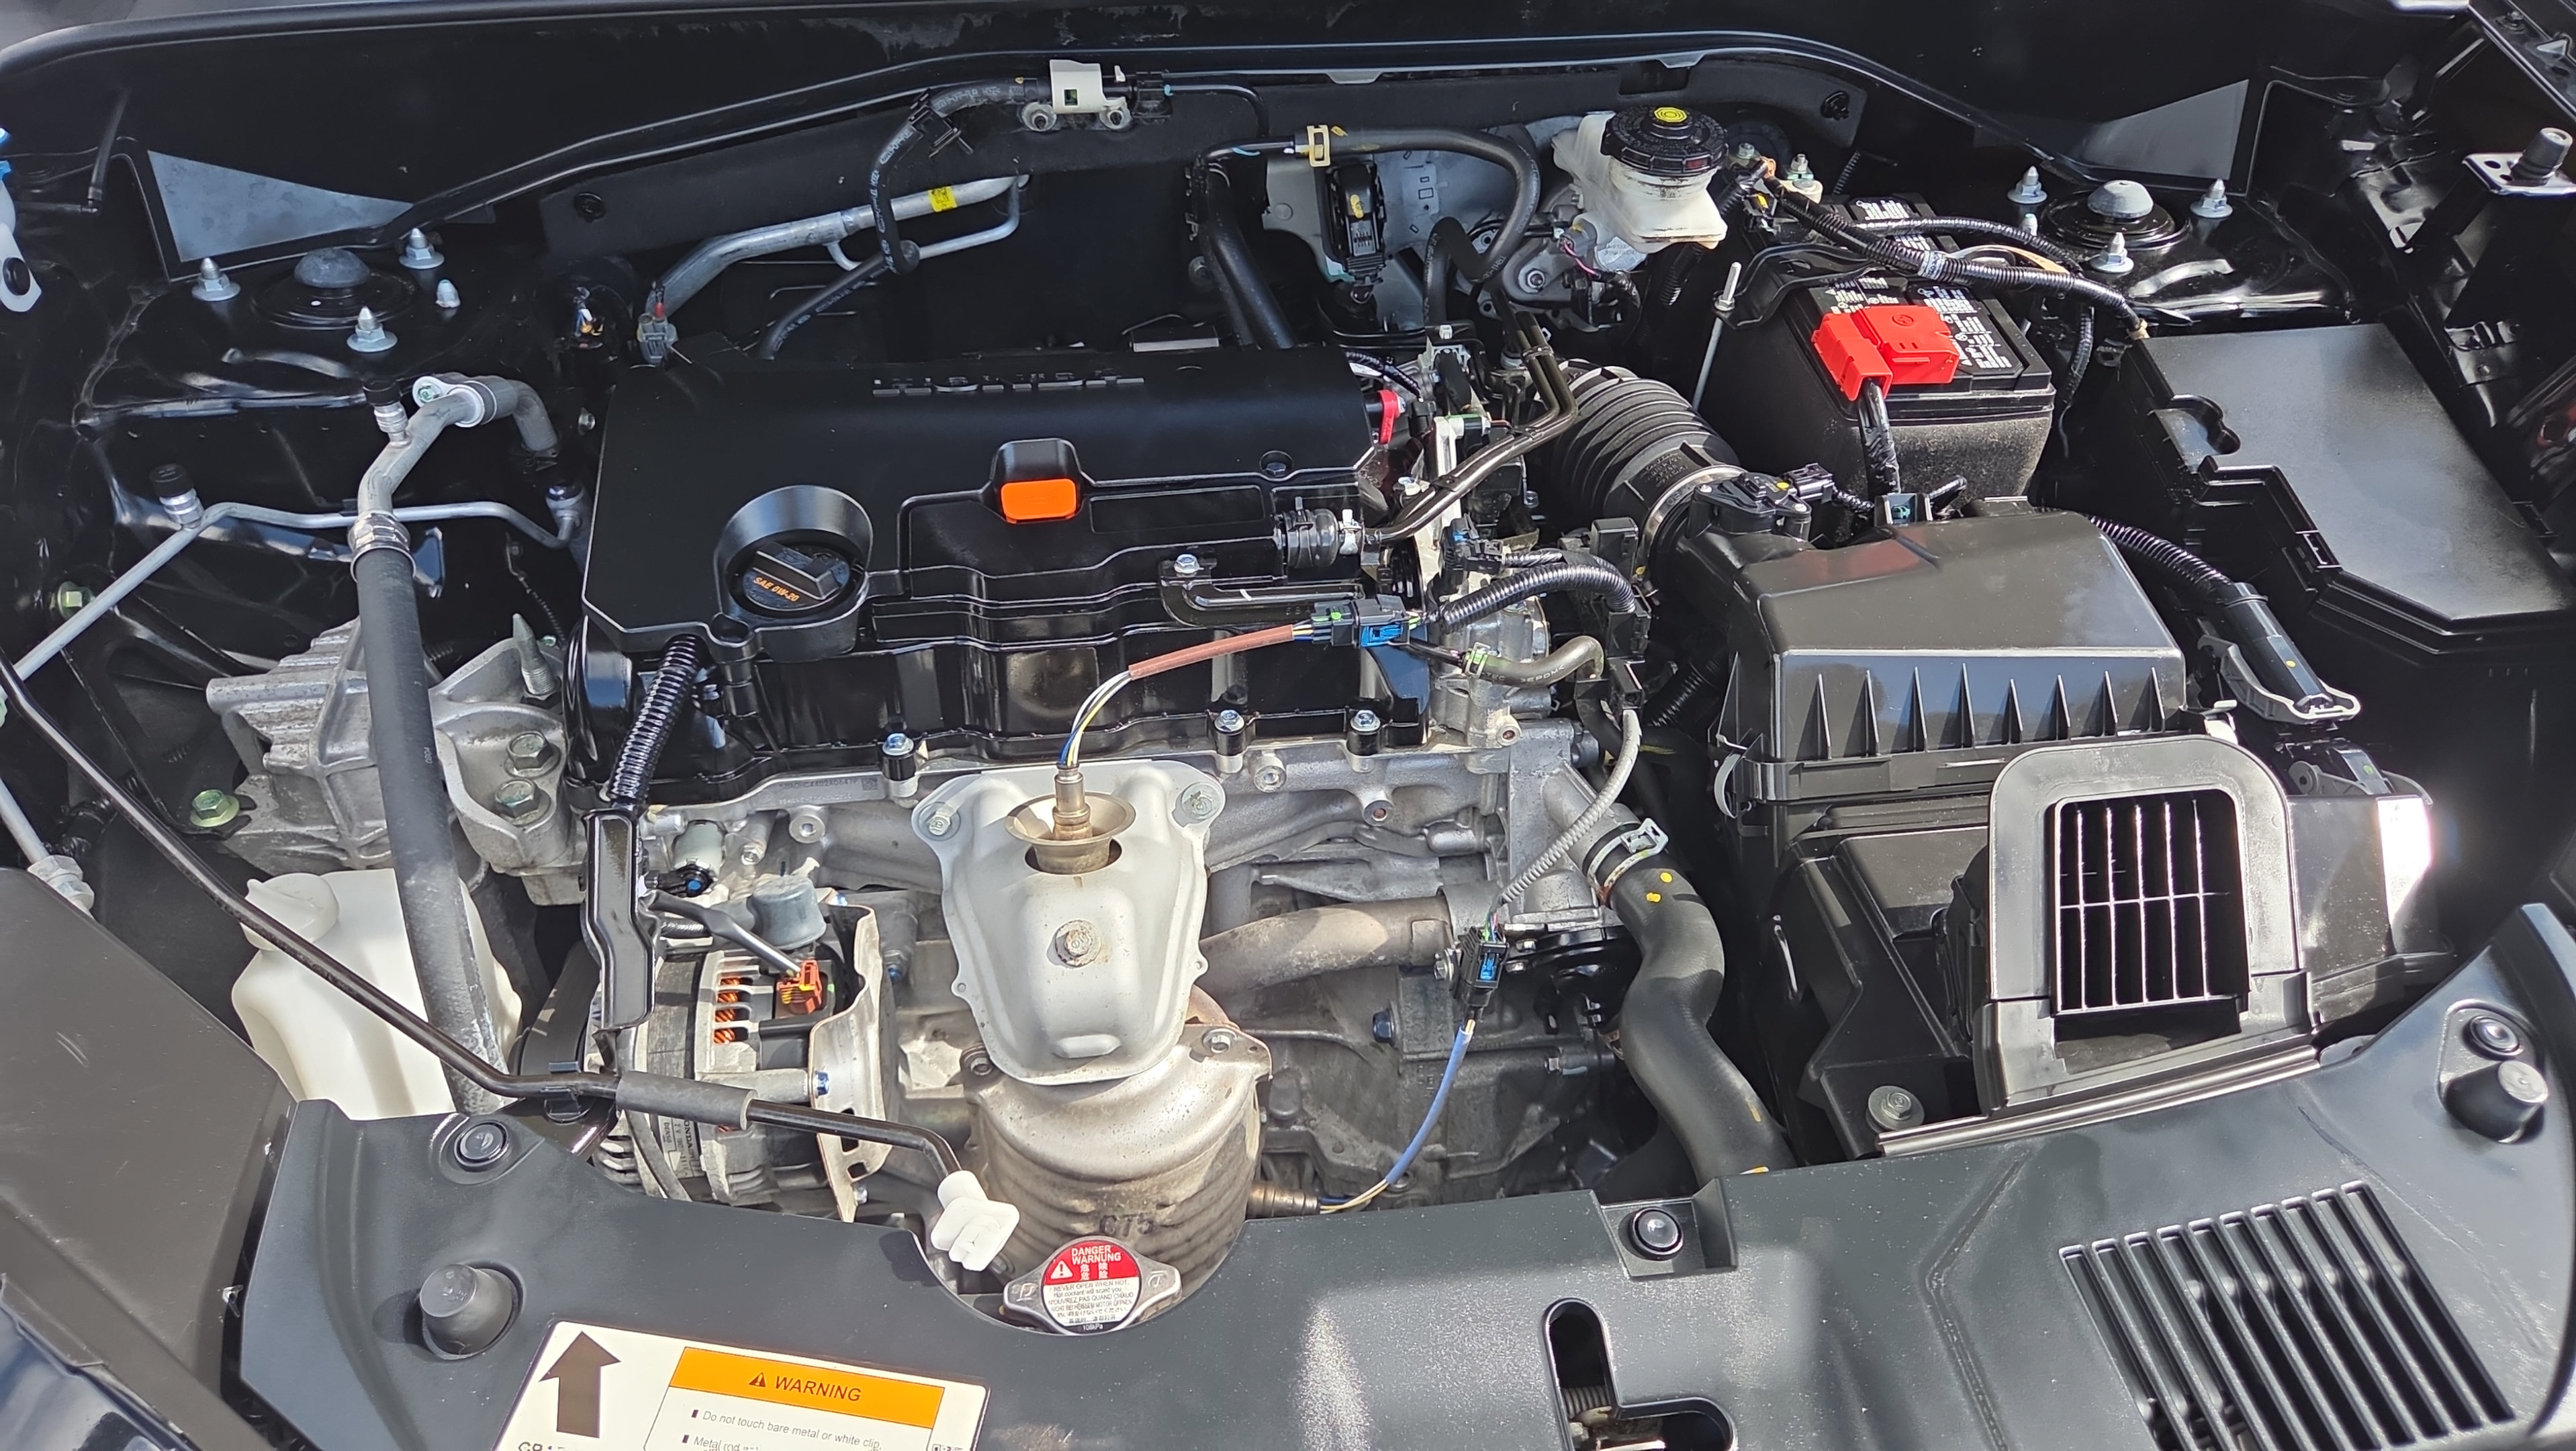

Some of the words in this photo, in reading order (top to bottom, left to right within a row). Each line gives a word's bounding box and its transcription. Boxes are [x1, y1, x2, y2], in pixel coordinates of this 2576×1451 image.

[752, 576, 772, 590] SAE
[771, 584, 800, 603] 0W-20
[684, 1120, 693, 1149] ONDA
[1071, 1245, 1111, 1256] DANGER
[1072, 1252, 1121, 1266] WARNUNG
[774, 1374, 862, 1403] WARNING
[694, 1436, 721, 1450] Metal
[702, 1411, 717, 1421] Do
[719, 1414, 736, 1425] not
[737, 1417, 764, 1430] touch
[767, 1421, 790, 1434] bare
[791, 1426, 819, 1439] metal
[821, 1432, 833, 1440] or
[835, 1434, 860, 1446] white
[863, 1438, 882, 1451] clip.
